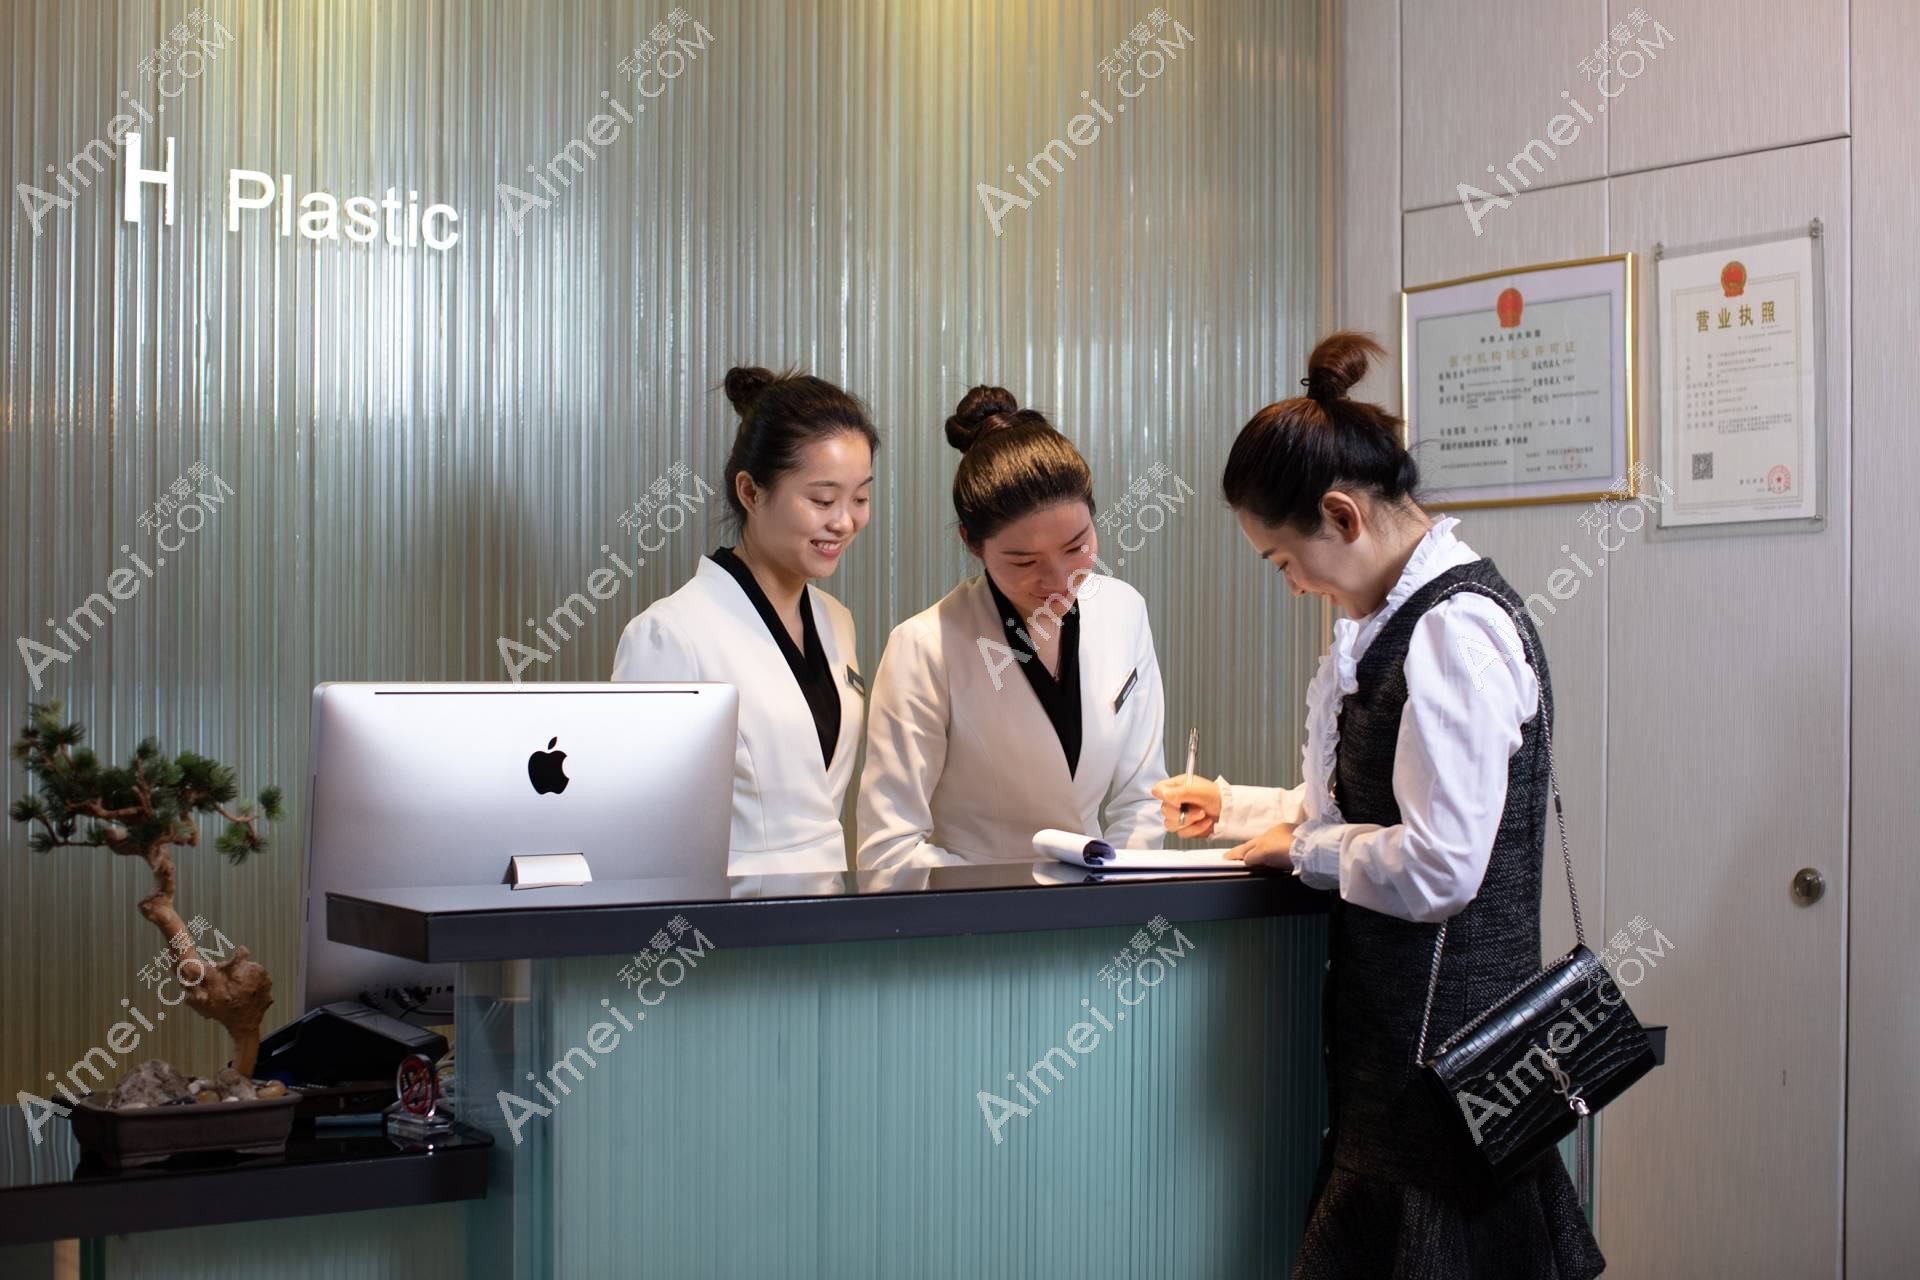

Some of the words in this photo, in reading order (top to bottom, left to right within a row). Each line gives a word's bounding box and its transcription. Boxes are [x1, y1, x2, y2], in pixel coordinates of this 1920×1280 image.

[124, 132, 175, 225] H
[228, 169, 459, 250] Plastic
[1696, 300, 1776, 333] 营业执照
